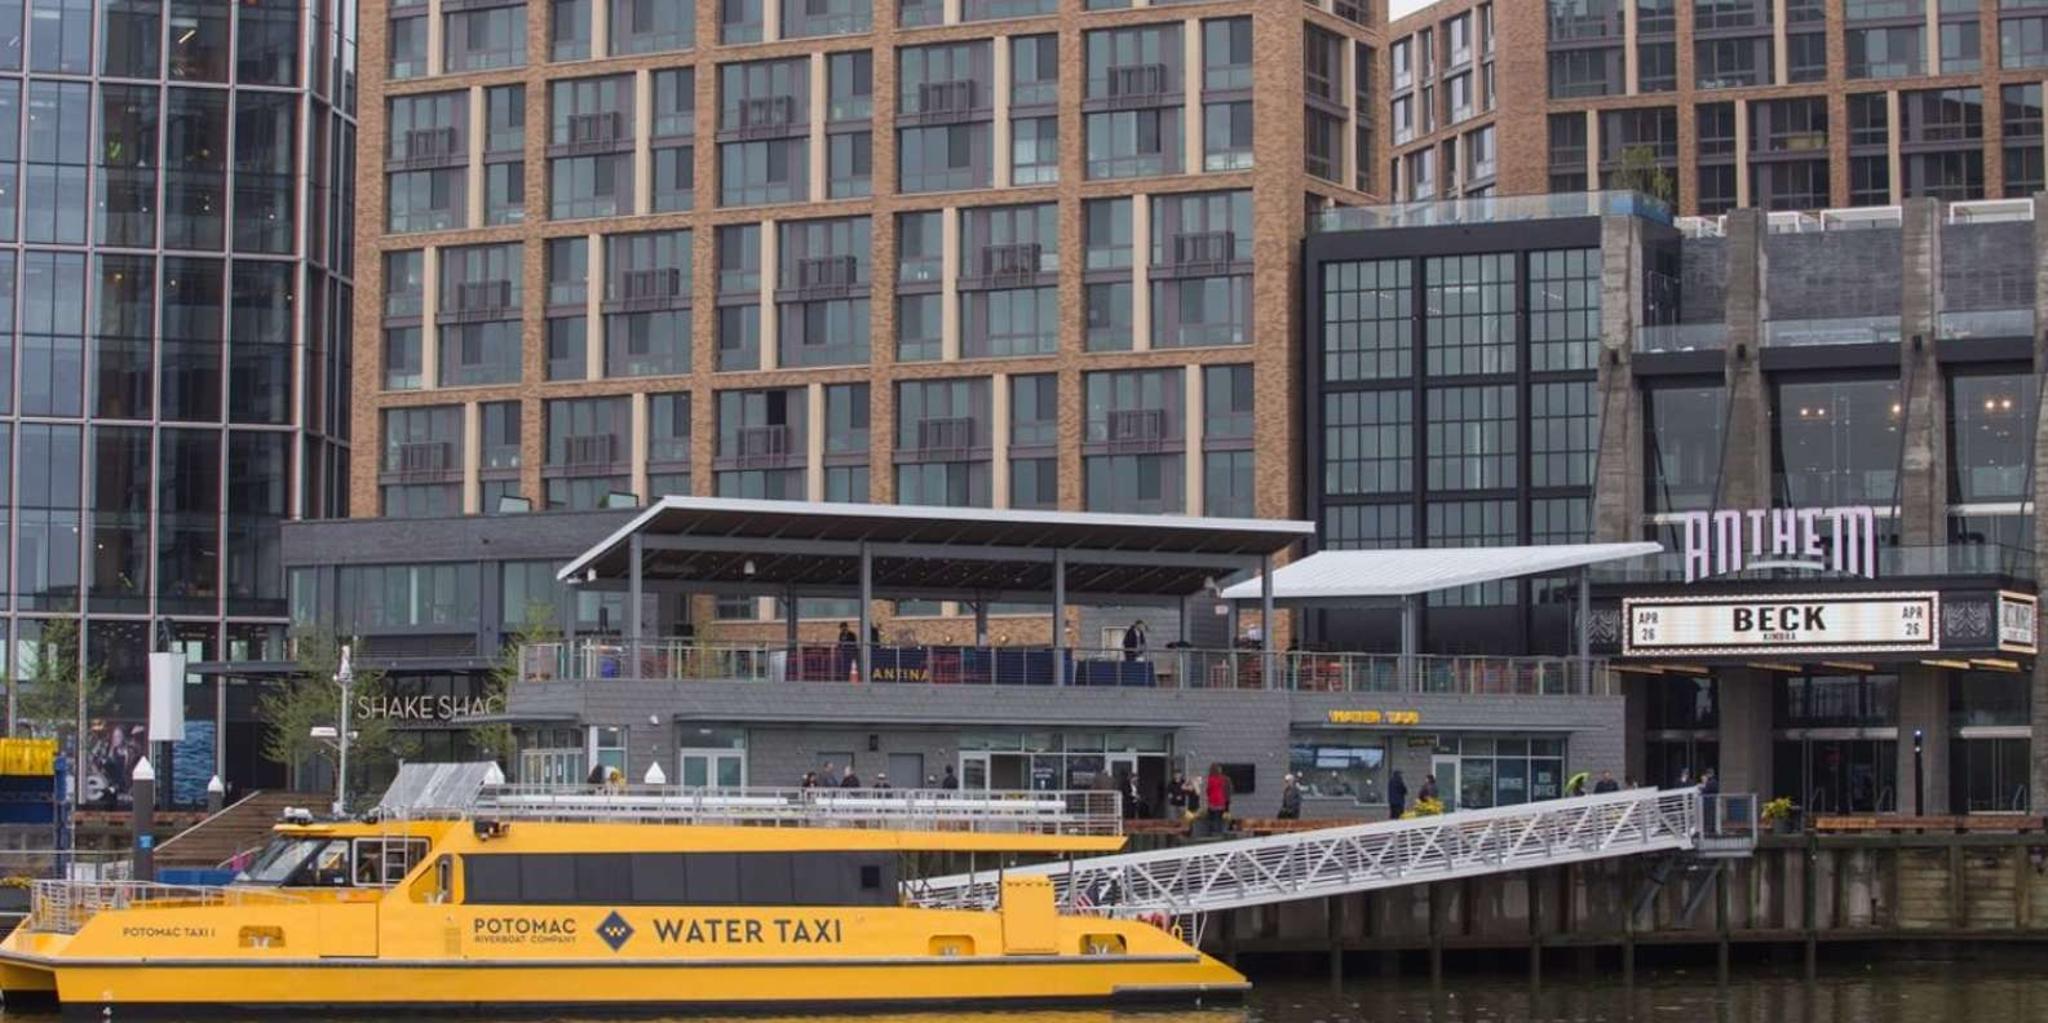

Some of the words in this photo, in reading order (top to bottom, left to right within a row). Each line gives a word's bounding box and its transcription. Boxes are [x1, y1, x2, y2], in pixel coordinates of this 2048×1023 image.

[1685, 506, 1877, 583] ANTHEM
[1638, 612, 1659, 624] APR
[1733, 606, 1827, 631] BECK
[1902, 606, 1923, 619] APR
[1642, 628, 1655, 641] 26
[1905, 622, 1919, 636] 26
[872, 668, 930, 680] ANTINA
[357, 695, 434, 719] SHAKE
[438, 695, 500, 719] SHAC
[123, 927, 180, 938] POTOMAC
[185, 927, 208, 937] TAXI
[474, 918, 577, 934] POTOMAC
[653, 919, 764, 943] WATER
[774, 919, 842, 943] TAXI
[474, 935, 526, 944] RIVERBOAT
[530, 935, 576, 944] COMPANY
